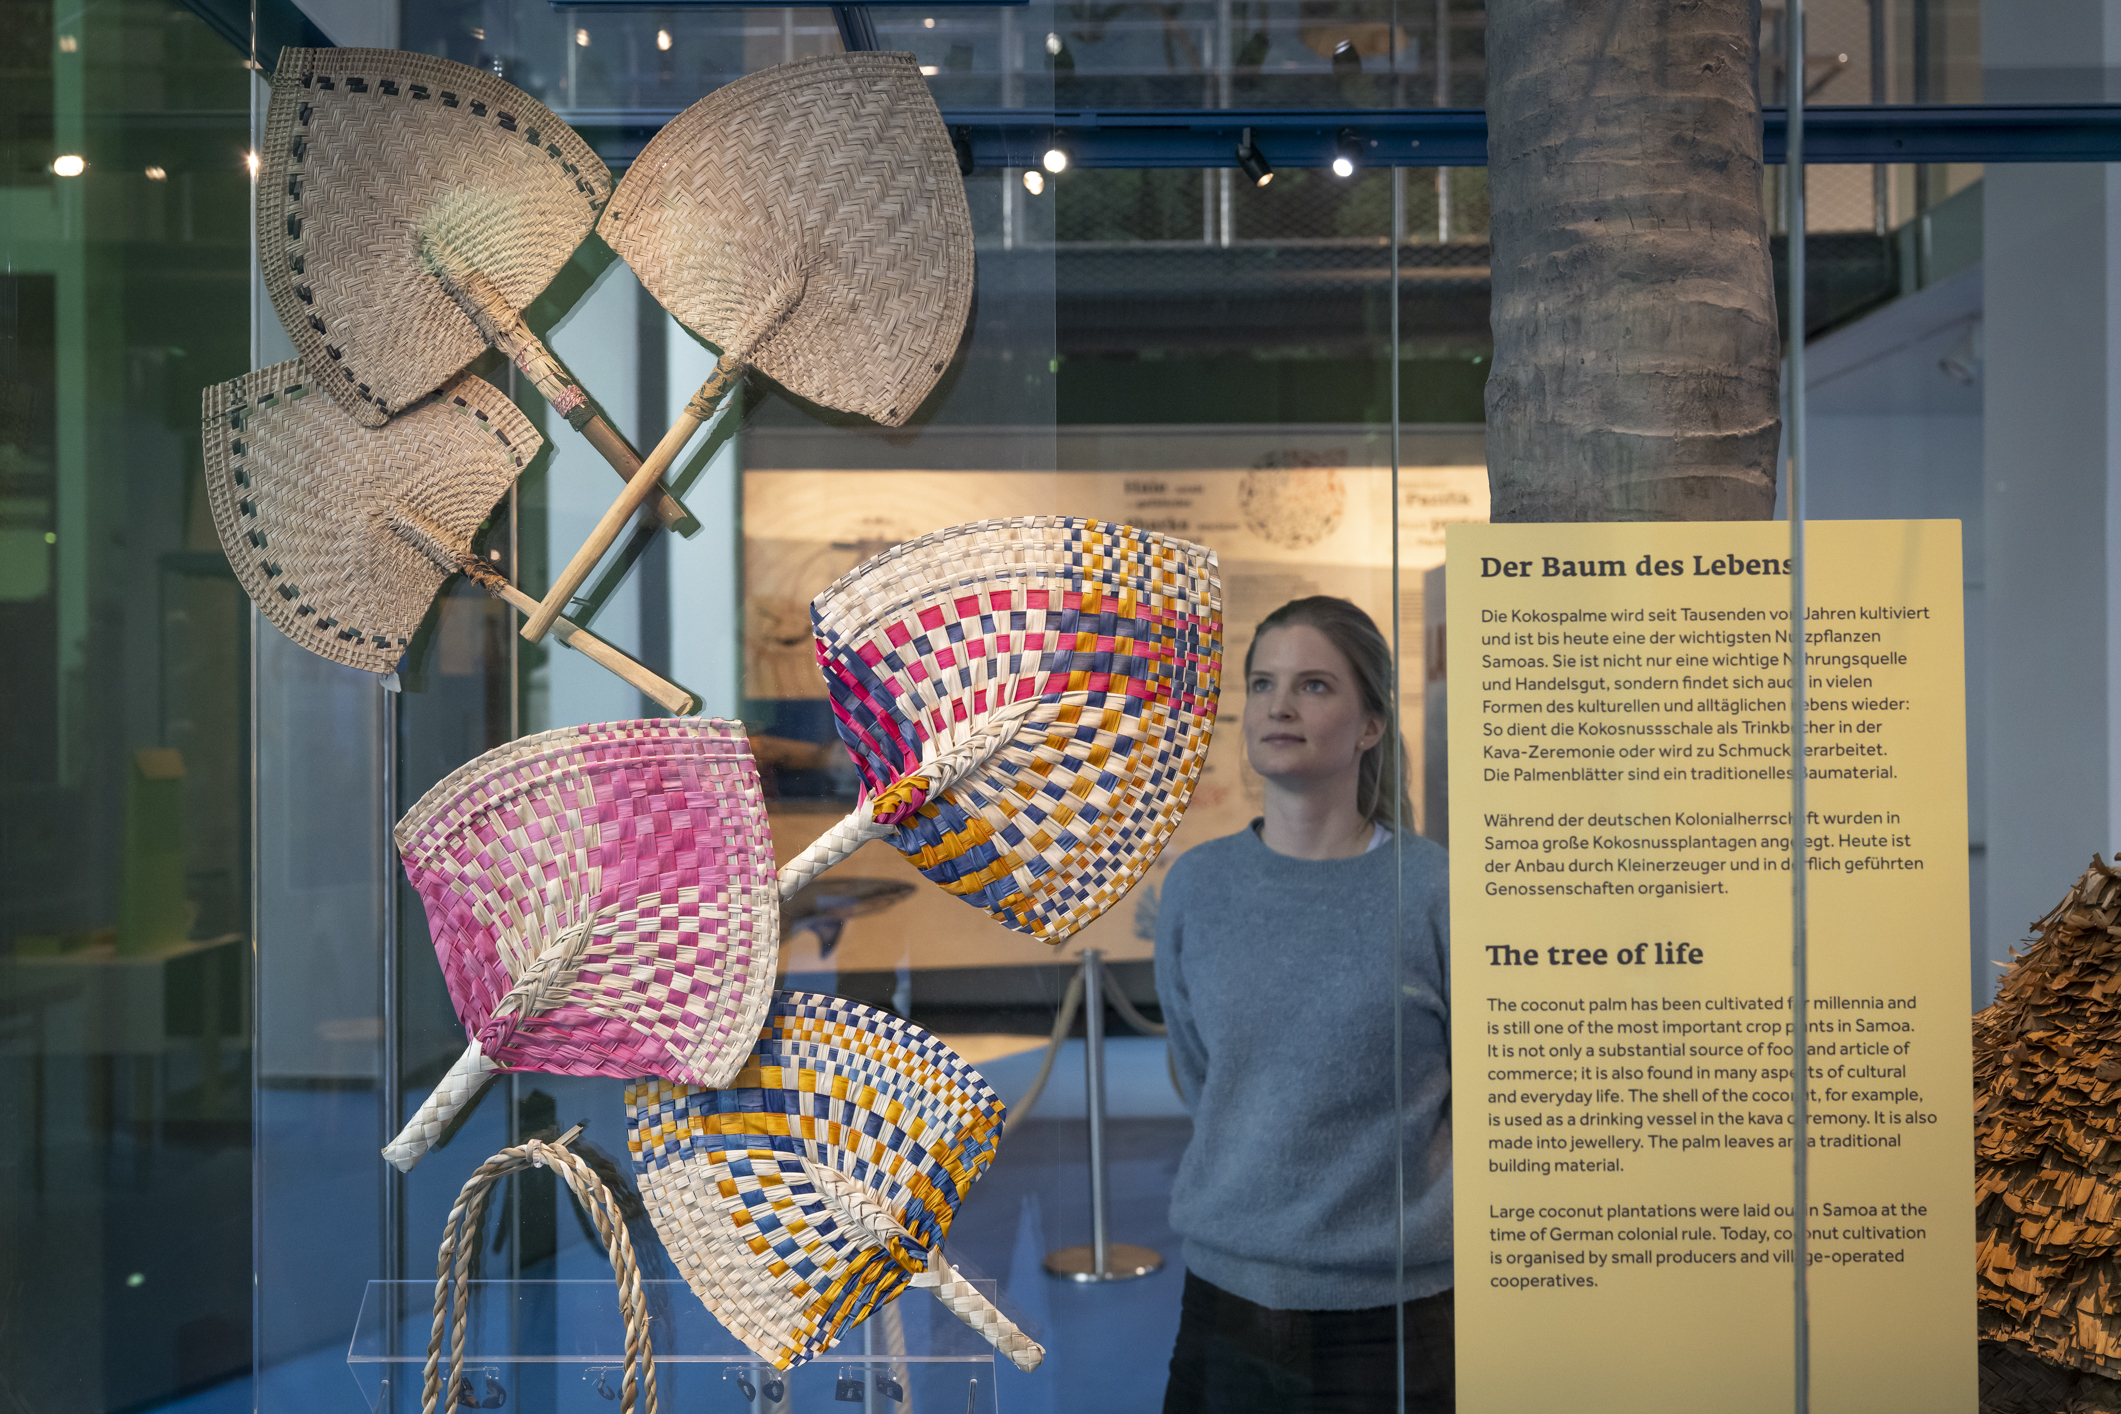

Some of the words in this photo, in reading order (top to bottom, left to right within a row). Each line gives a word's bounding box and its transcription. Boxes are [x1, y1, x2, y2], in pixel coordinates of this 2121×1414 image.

[1481, 555, 1533, 578] Der
[1541, 555, 1627, 578] Baum
[1636, 554, 1684, 577] des
[1693, 553, 1794, 576] Lebens
[1481, 609, 1508, 624] Die
[1511, 607, 1608, 627] Kokospalme
[1610, 607, 1645, 623] wird
[1647, 607, 1678, 622] seit
[1679, 606, 1766, 622] Tausenden
[1804, 606, 1857, 621] Jahren
[1859, 605, 1931, 620] kultiviert
[1514, 631, 1535, 646] ist
[1537, 631, 1560, 646] bis
[1562, 631, 1610, 646] heute
[1612, 630, 1646, 646] eine
[1678, 629, 1772, 648] wichtigsten
[1774, 628, 1882, 648] Nuzpflanzen
[1481, 654, 1549, 669] Samoas.
[1552, 653, 1577, 669] Sie
[1579, 653, 1600, 668] ist
[1602, 653, 1643, 668] nicht
[1645, 656, 1673, 668] nur
[1675, 653, 1710, 668] eine
[1711, 652, 1780, 671] wichtige
[1782, 650, 1908, 670] Nhrungsquelle
[1515, 675, 1611, 696] Handelsgut,
[1613, 675, 1679, 691] sondern
[1681, 673, 1730, 691] findet
[1732, 674, 1764, 690] sich
[1766, 678, 1795, 690] auc
[1825, 674, 1873, 690] vielen
[1482, 698, 1543, 715] Formen
[1545, 699, 1575, 714] des
[1577, 697, 1661, 714] kulturellen
[1663, 698, 1694, 713] und
[1696, 697, 1787, 716] alltäglichen
[1851, 696, 1910, 711] wieder:
[1506, 722, 1548, 737] dient
[1550, 721, 1575, 737] die
[1578, 720, 1714, 737] Kokosnussschale
[1716, 720, 1739, 735] als
[1741, 719, 1836, 736] Trinkbcher
[1483, 743, 1616, 761] Kava-Zeremonie
[1618, 743, 1656, 759] oder
[1658, 742, 1693, 759] wird
[1718, 742, 1791, 758] Schmuck
[1804, 742, 1888, 758] erarbeitet.
[1483, 767, 1511, 782] Die
[1513, 766, 1625, 783] Palmenblätter
[1627, 766, 1660, 782] sind
[1663, 766, 1688, 781] ein
[1689, 764, 1794, 782] traditionelles
[1483, 812, 1555, 828] Während
[1557, 811, 1585, 828] der
[1587, 812, 1672, 827] deutschen
[1674, 810, 1821, 827] Kolonialherrschft
[1822, 810, 1883, 826] wurden
[1484, 835, 1539, 851] Samoa
[1541, 835, 1590, 854] große
[1592, 833, 1758, 854] Kokosnussplantagen
[1838, 832, 1889, 849] Heute
[1484, 858, 1512, 874] der
[1514, 857, 1565, 874] Anbau
[1567, 857, 1614, 873] durch
[1617, 856, 1727, 877] Kleinerzeuger
[1729, 856, 1760, 872] und
[1844, 854, 1924, 875] geführten
[1484, 879, 1635, 897] Genossenschaften
[1637, 880, 1729, 899] organisiert.
[1485, 944, 1539, 967] The
[1547, 945, 1608, 966] tree
[1617, 941, 1650, 966] of
[1655, 941, 1704, 966] life
[1485, 997, 1518, 1012] The
[1520, 997, 1586, 1013] coconut
[1588, 996, 1628, 1015] palm
[1630, 996, 1659, 1012] has
[1661, 996, 1702, 1012] been
[1704, 995, 1784, 1012] cultivated
[1786, 994, 1811, 1011] fr
[1813, 994, 1885, 1011] millennia
[1887, 995, 1917, 1010] and
[1502, 1020, 1531, 1036] still
[1533, 1023, 1564, 1035] one
[1586, 1019, 1614, 1035] the
[1617, 1020, 1660, 1036] most
[1662, 1019, 1744, 1038] important
[1745, 1022, 1782, 1037] crop
[1855, 1017, 1915, 1034] Samoa.
[1518, 1043, 1546, 1058] not
[1548, 1042, 1583, 1062] only
[1598, 1042, 1686, 1058] substantial
[1689, 1045, 1744, 1057] source
[1766, 1041, 1794, 1057] foo
[1806, 1041, 1837, 1056] and
[1839, 1041, 1890, 1056] article
[1487, 1069, 1578, 1083] commerce;
[1611, 1065, 1644, 1081] also
[1646, 1064, 1694, 1081] found
[1714, 1068, 1758, 1083] many
[1760, 1065, 1824, 1084] aspets
[1847, 1064, 1907, 1080] cultural
[1487, 1089, 1517, 1104] and
[1520, 1088, 1593, 1108] everyday
[1595, 1087, 1625, 1104] life.
[1627, 1088, 1659, 1104] The
[1662, 1087, 1699, 1103] shell
[1721, 1087, 1749, 1103] the
[1824, 1087, 1849, 1102] for
[1850, 1086, 1924, 1105] example,
[1504, 1112, 1543, 1127] used
[1579, 1111, 1644, 1130] drinking
[1646, 1111, 1697, 1127] vessel
[1717, 1110, 1745, 1126] the
[1747, 1110, 1784, 1126] kava
[1786, 1112, 1871, 1129] cremony.
[1904, 1110, 1938, 1125] also
[1488, 1135, 1534, 1151] made
[1537, 1134, 1568, 1150] into
[1568, 1134, 1644, 1153] jewellery.
[1647, 1134, 1679, 1149] The
[1681, 1133, 1721, 1153] palm
[1724, 1133, 1775, 1149] leaves
[1777, 1136, 1795, 1149] ar
[1818, 1133, 1902, 1148] traditional
[1488, 1157, 1551, 1177] building
[1554, 1157, 1625, 1173] material.
[1489, 1204, 1536, 1223] Large
[1538, 1204, 1604, 1220] coconut
[1606, 1203, 1697, 1222] plantations
[1699, 1206, 1740, 1218] were
[1743, 1202, 1771, 1218] laid
[1773, 1206, 1794, 1218] ou
[1822, 1201, 1878, 1218] Samoa
[1900, 1202, 1928, 1217] the
[1488, 1227, 1527, 1242] time
[1549, 1226, 1614, 1242] German
[1617, 1225, 1678, 1243] colonial
[1681, 1226, 1717, 1241] rule.
[1719, 1225, 1770, 1245] Today,
[1842, 1224, 1927, 1241] cultivation
[1505, 1249, 1585, 1269] organised
[1611, 1249, 1653, 1265] small
[1655, 1248, 1737, 1268] producers
[1739, 1248, 1770, 1264] and
[1772, 1248, 1905, 1268] villge-operated
[1490, 1272, 1598, 1292] cooperatives.
